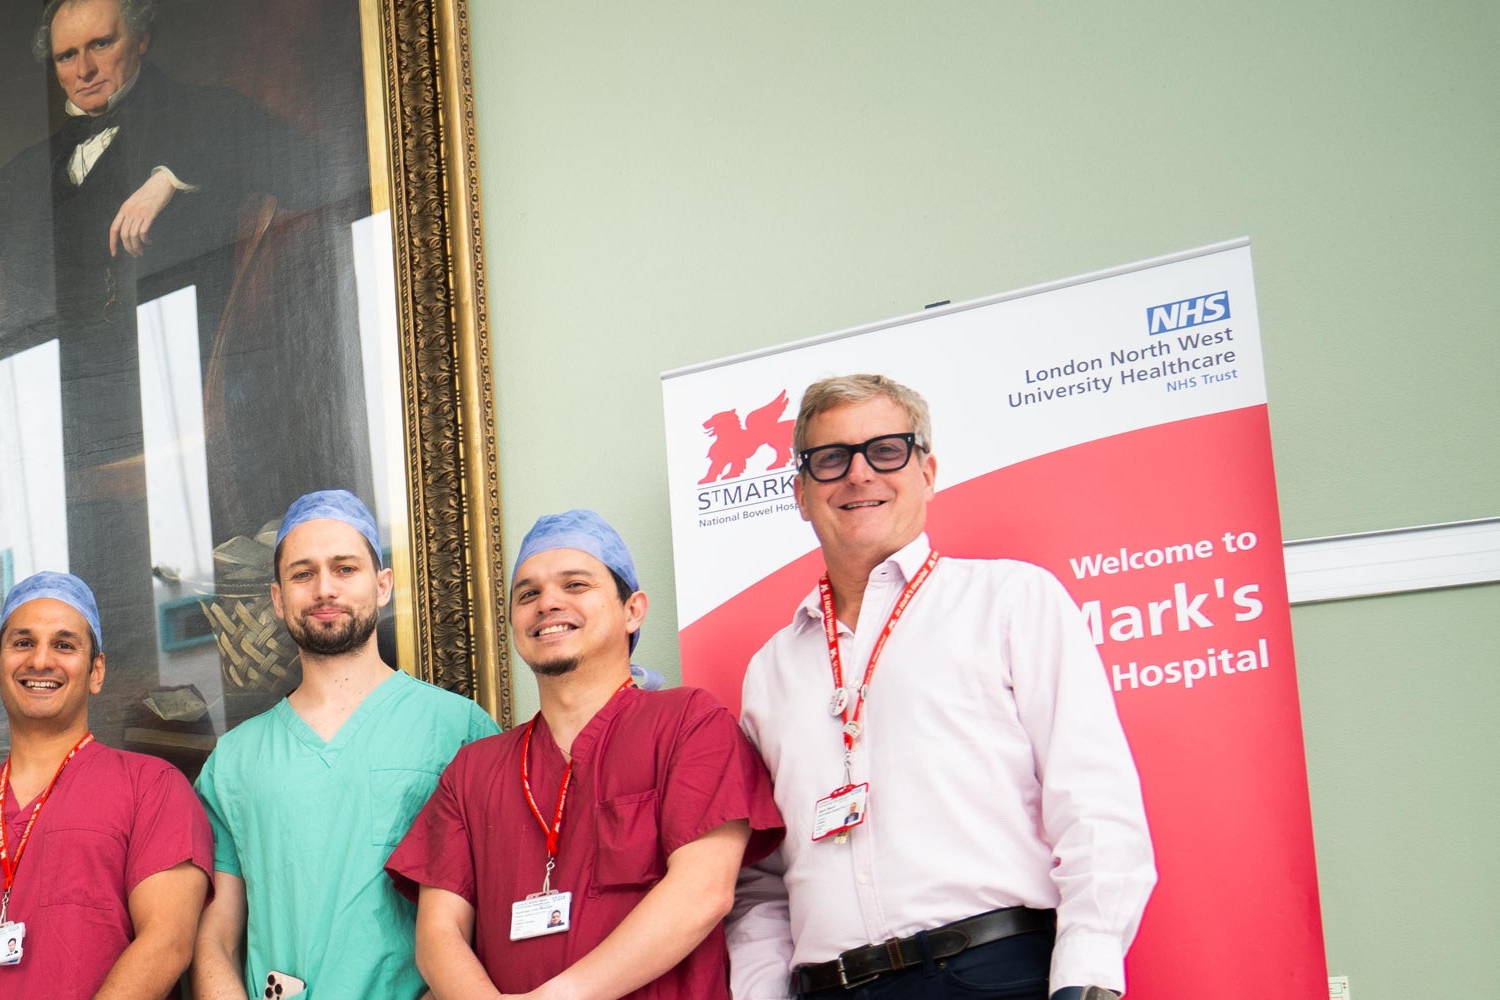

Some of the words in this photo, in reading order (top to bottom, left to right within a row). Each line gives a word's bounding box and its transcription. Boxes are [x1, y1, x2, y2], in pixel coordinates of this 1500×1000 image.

[1150, 292, 1226, 334] NHS
[1025, 358, 1102, 384] London
[1110, 340, 1171, 366] North
[1177, 327, 1234, 351] West
[1008, 375, 1113, 407] University
[1120, 351, 1236, 385] Healthcare
[1166, 378, 1197, 393] NHS
[1201, 368, 1238, 385] Trust
[699, 512, 740, 528] National
[743, 505, 773, 519] Bowel
[776, 502, 801, 513] Hosp
[1069, 539, 1214, 580] Welcome
[1221, 531, 1257, 553] to
[911, 569, 928, 591] Hospital
[1111, 638, 1269, 692] Hospital
